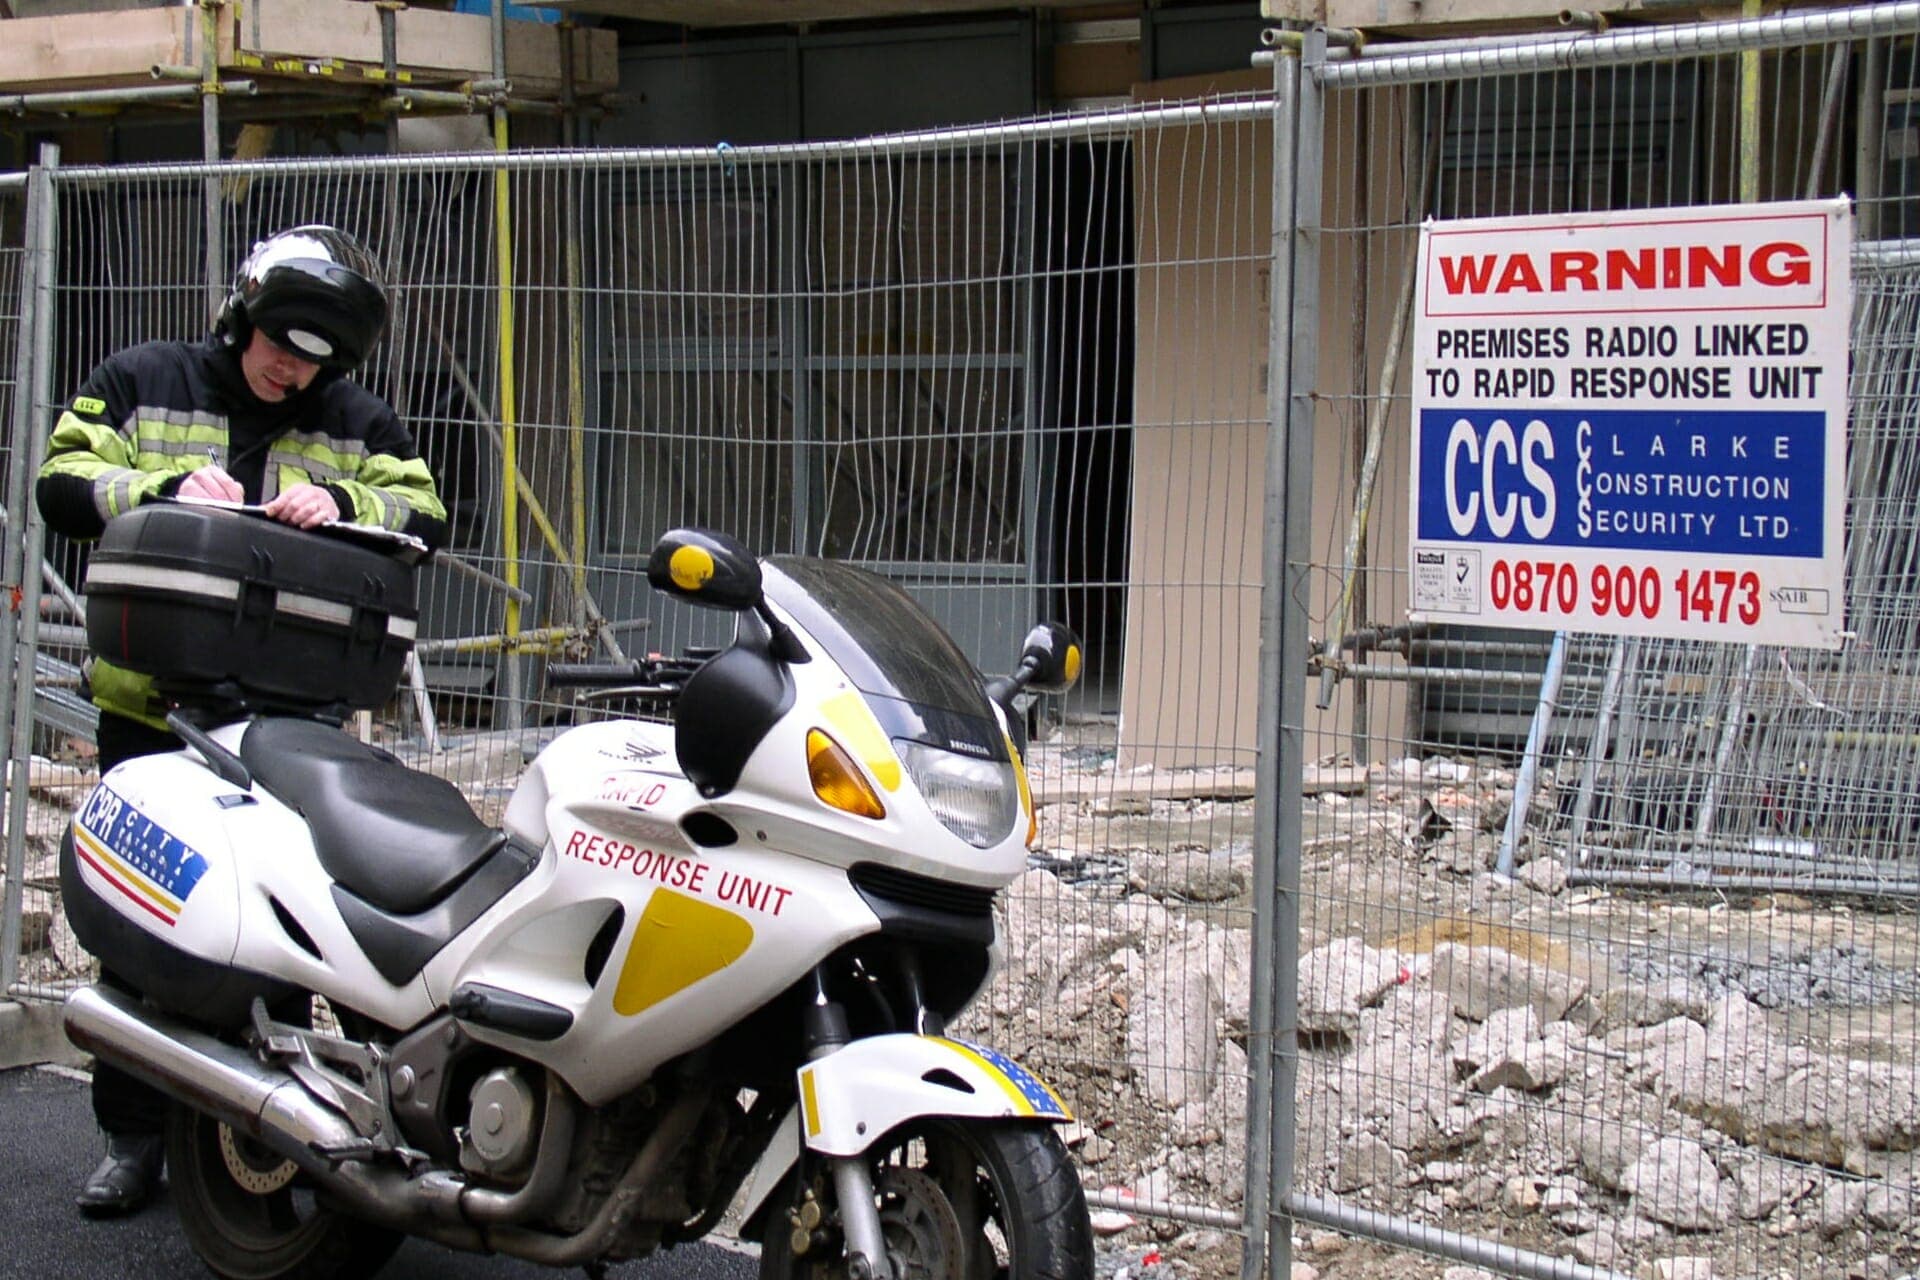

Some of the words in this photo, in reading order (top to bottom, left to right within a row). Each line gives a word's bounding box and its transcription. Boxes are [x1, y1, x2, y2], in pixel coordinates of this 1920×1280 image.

[1439, 242, 1811, 295] WARNING
[1437, 327, 1570, 359] PREMISES
[1586, 325, 1677, 358] RADIO
[1695, 324, 1809, 357] LINKED
[1426, 368, 1460, 398] TO
[1473, 367, 1556, 398] RAPID
[1571, 367, 1731, 399] RESPONSE
[1749, 366, 1823, 399] UNIT
[1576, 420, 1789, 460] CLARKE
[1445, 418, 1556, 540] CCS
[1576, 460, 1790, 500] CONSTRUCTION
[1577, 500, 1716, 538] SECURITY
[1739, 515, 1789, 539] LTD
[1490, 559, 1578, 615] 0870
[1591, 564, 1661, 619] 900
[1675, 569, 1761, 626] 1473
[949, 740, 991, 756] HONDA
[84, 784, 124, 841] CPR
[126, 811, 194, 865] CITY
[565, 830, 710, 893] RESPONSE
[717, 871, 793, 916] UNIT
